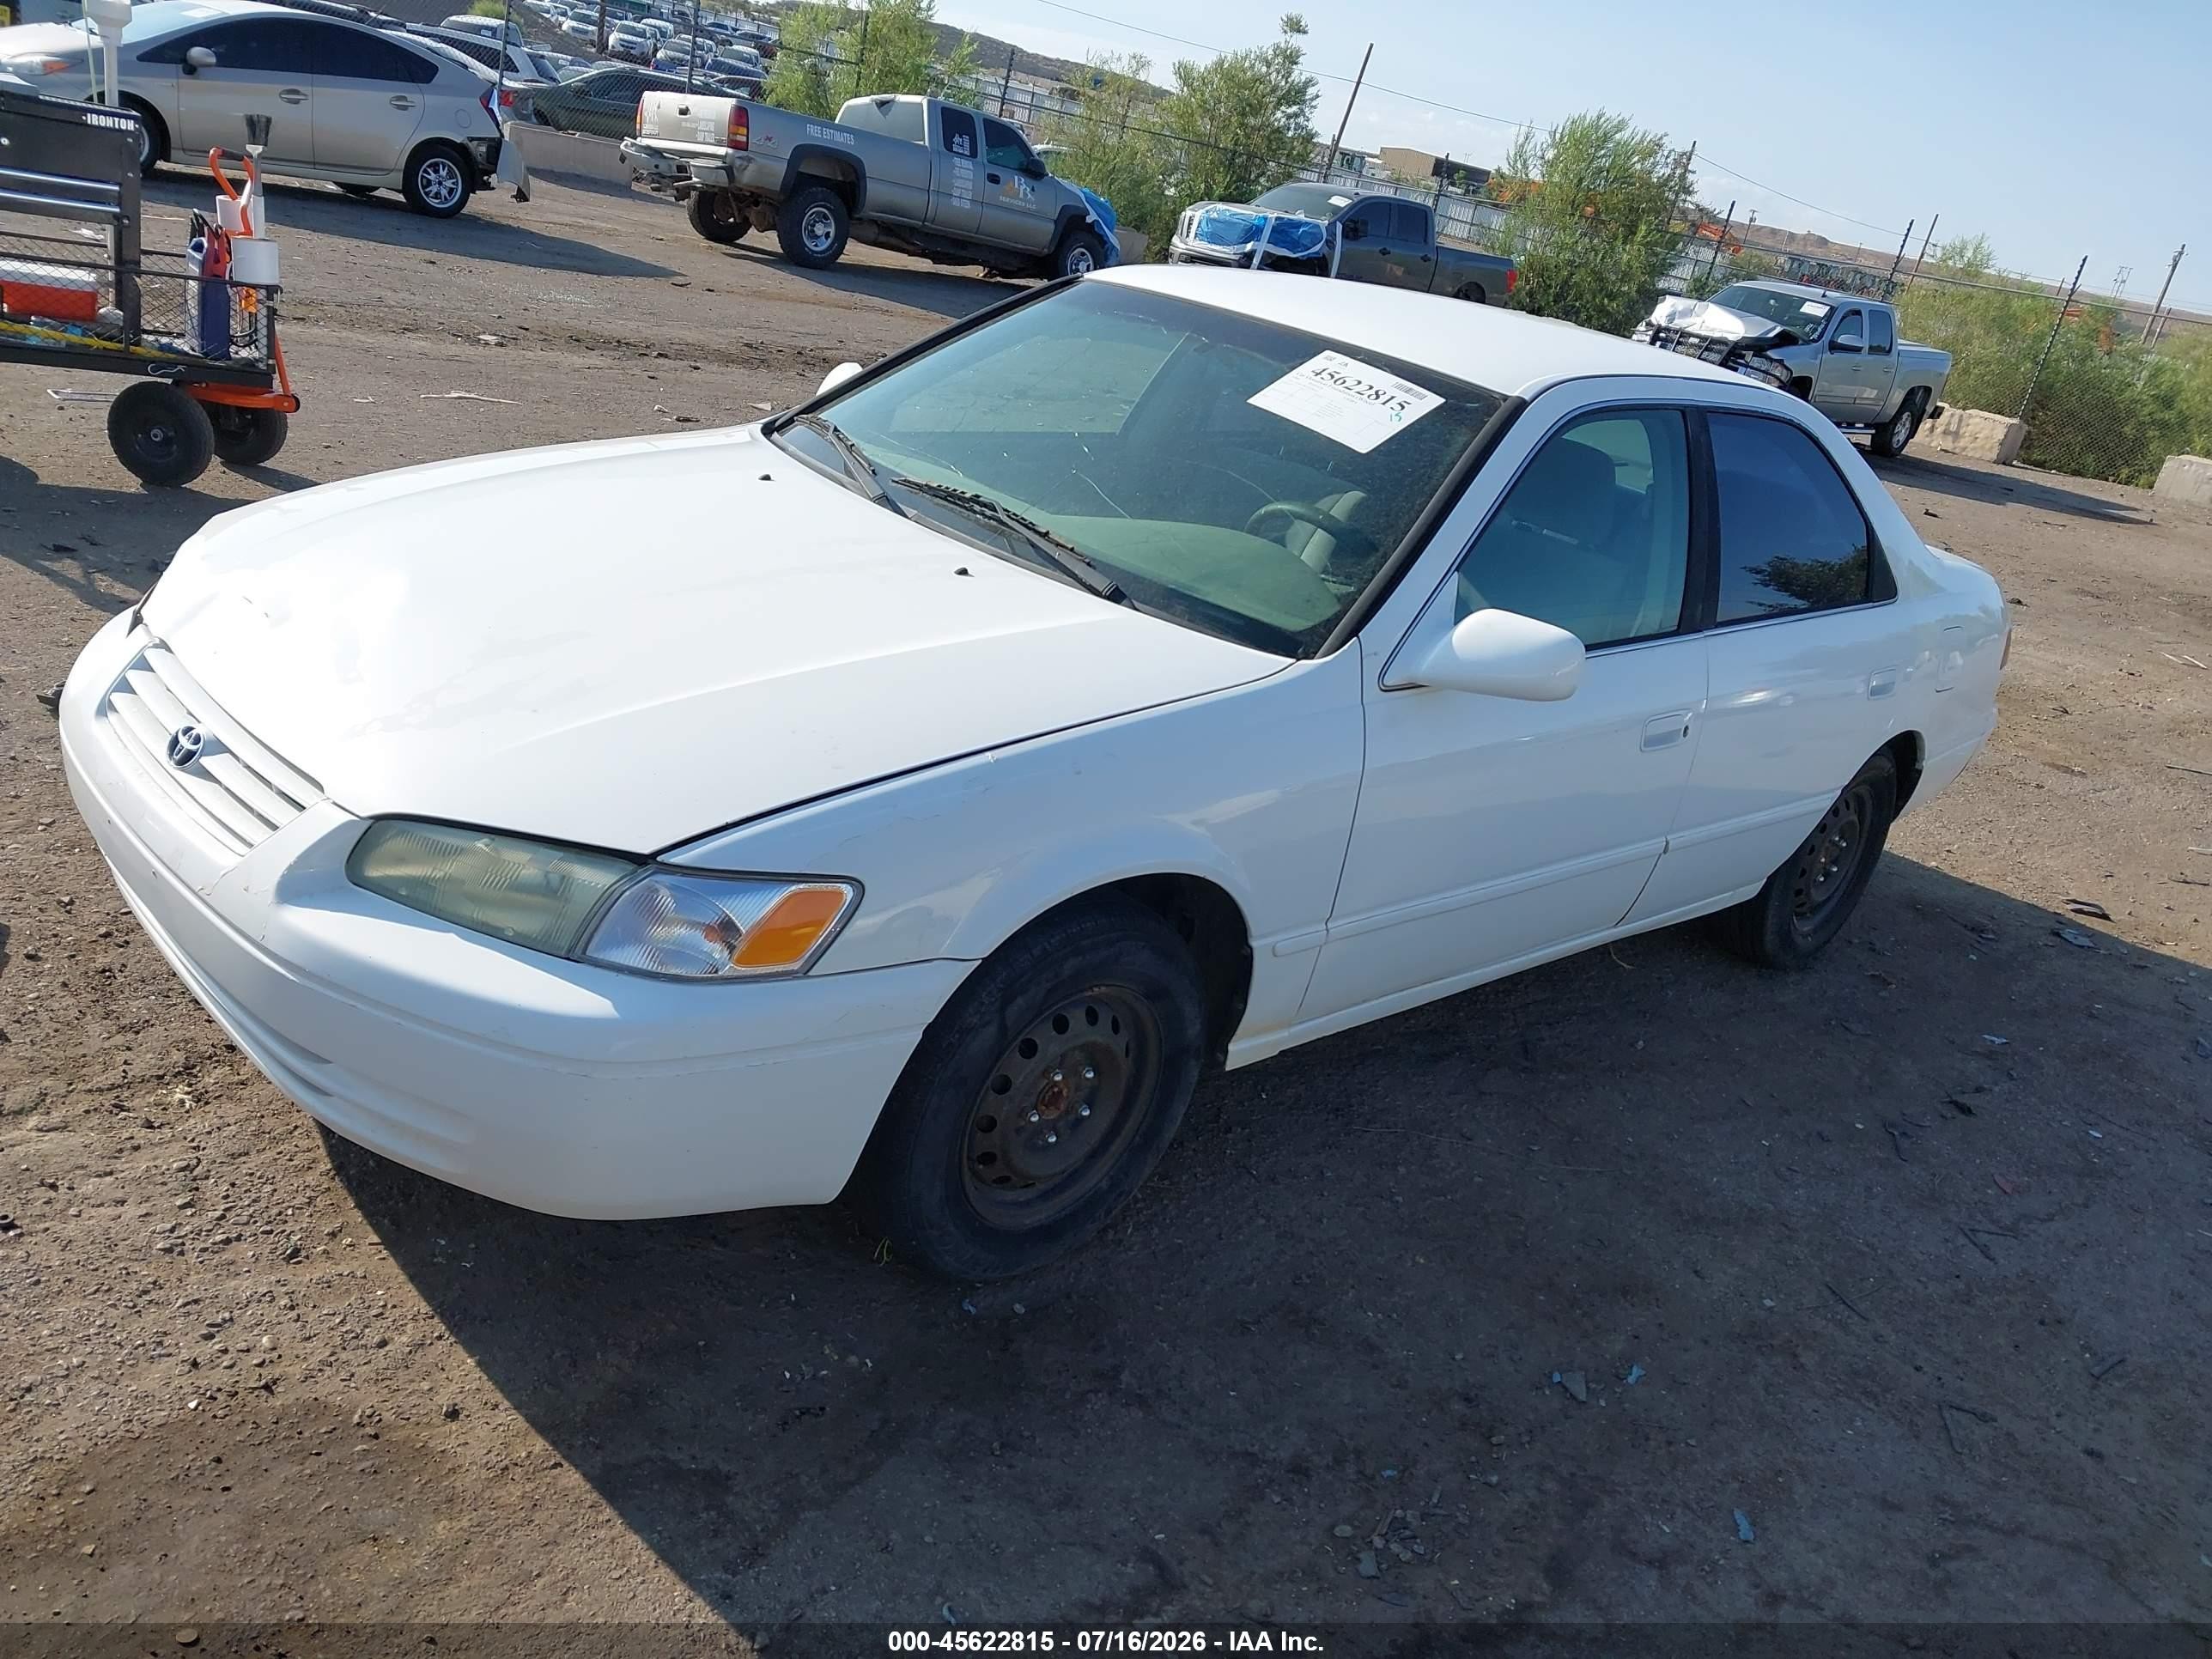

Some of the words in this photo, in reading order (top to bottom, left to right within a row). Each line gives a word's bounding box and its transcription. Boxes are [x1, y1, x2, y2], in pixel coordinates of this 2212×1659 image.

[87, 112, 135, 131] IRONTON
[806, 124, 822, 137] FREE
[823, 127, 854, 145] ESTIMATES
[999, 195, 1025, 207] SERVICES
[1310, 367, 1412, 412] 45622815
